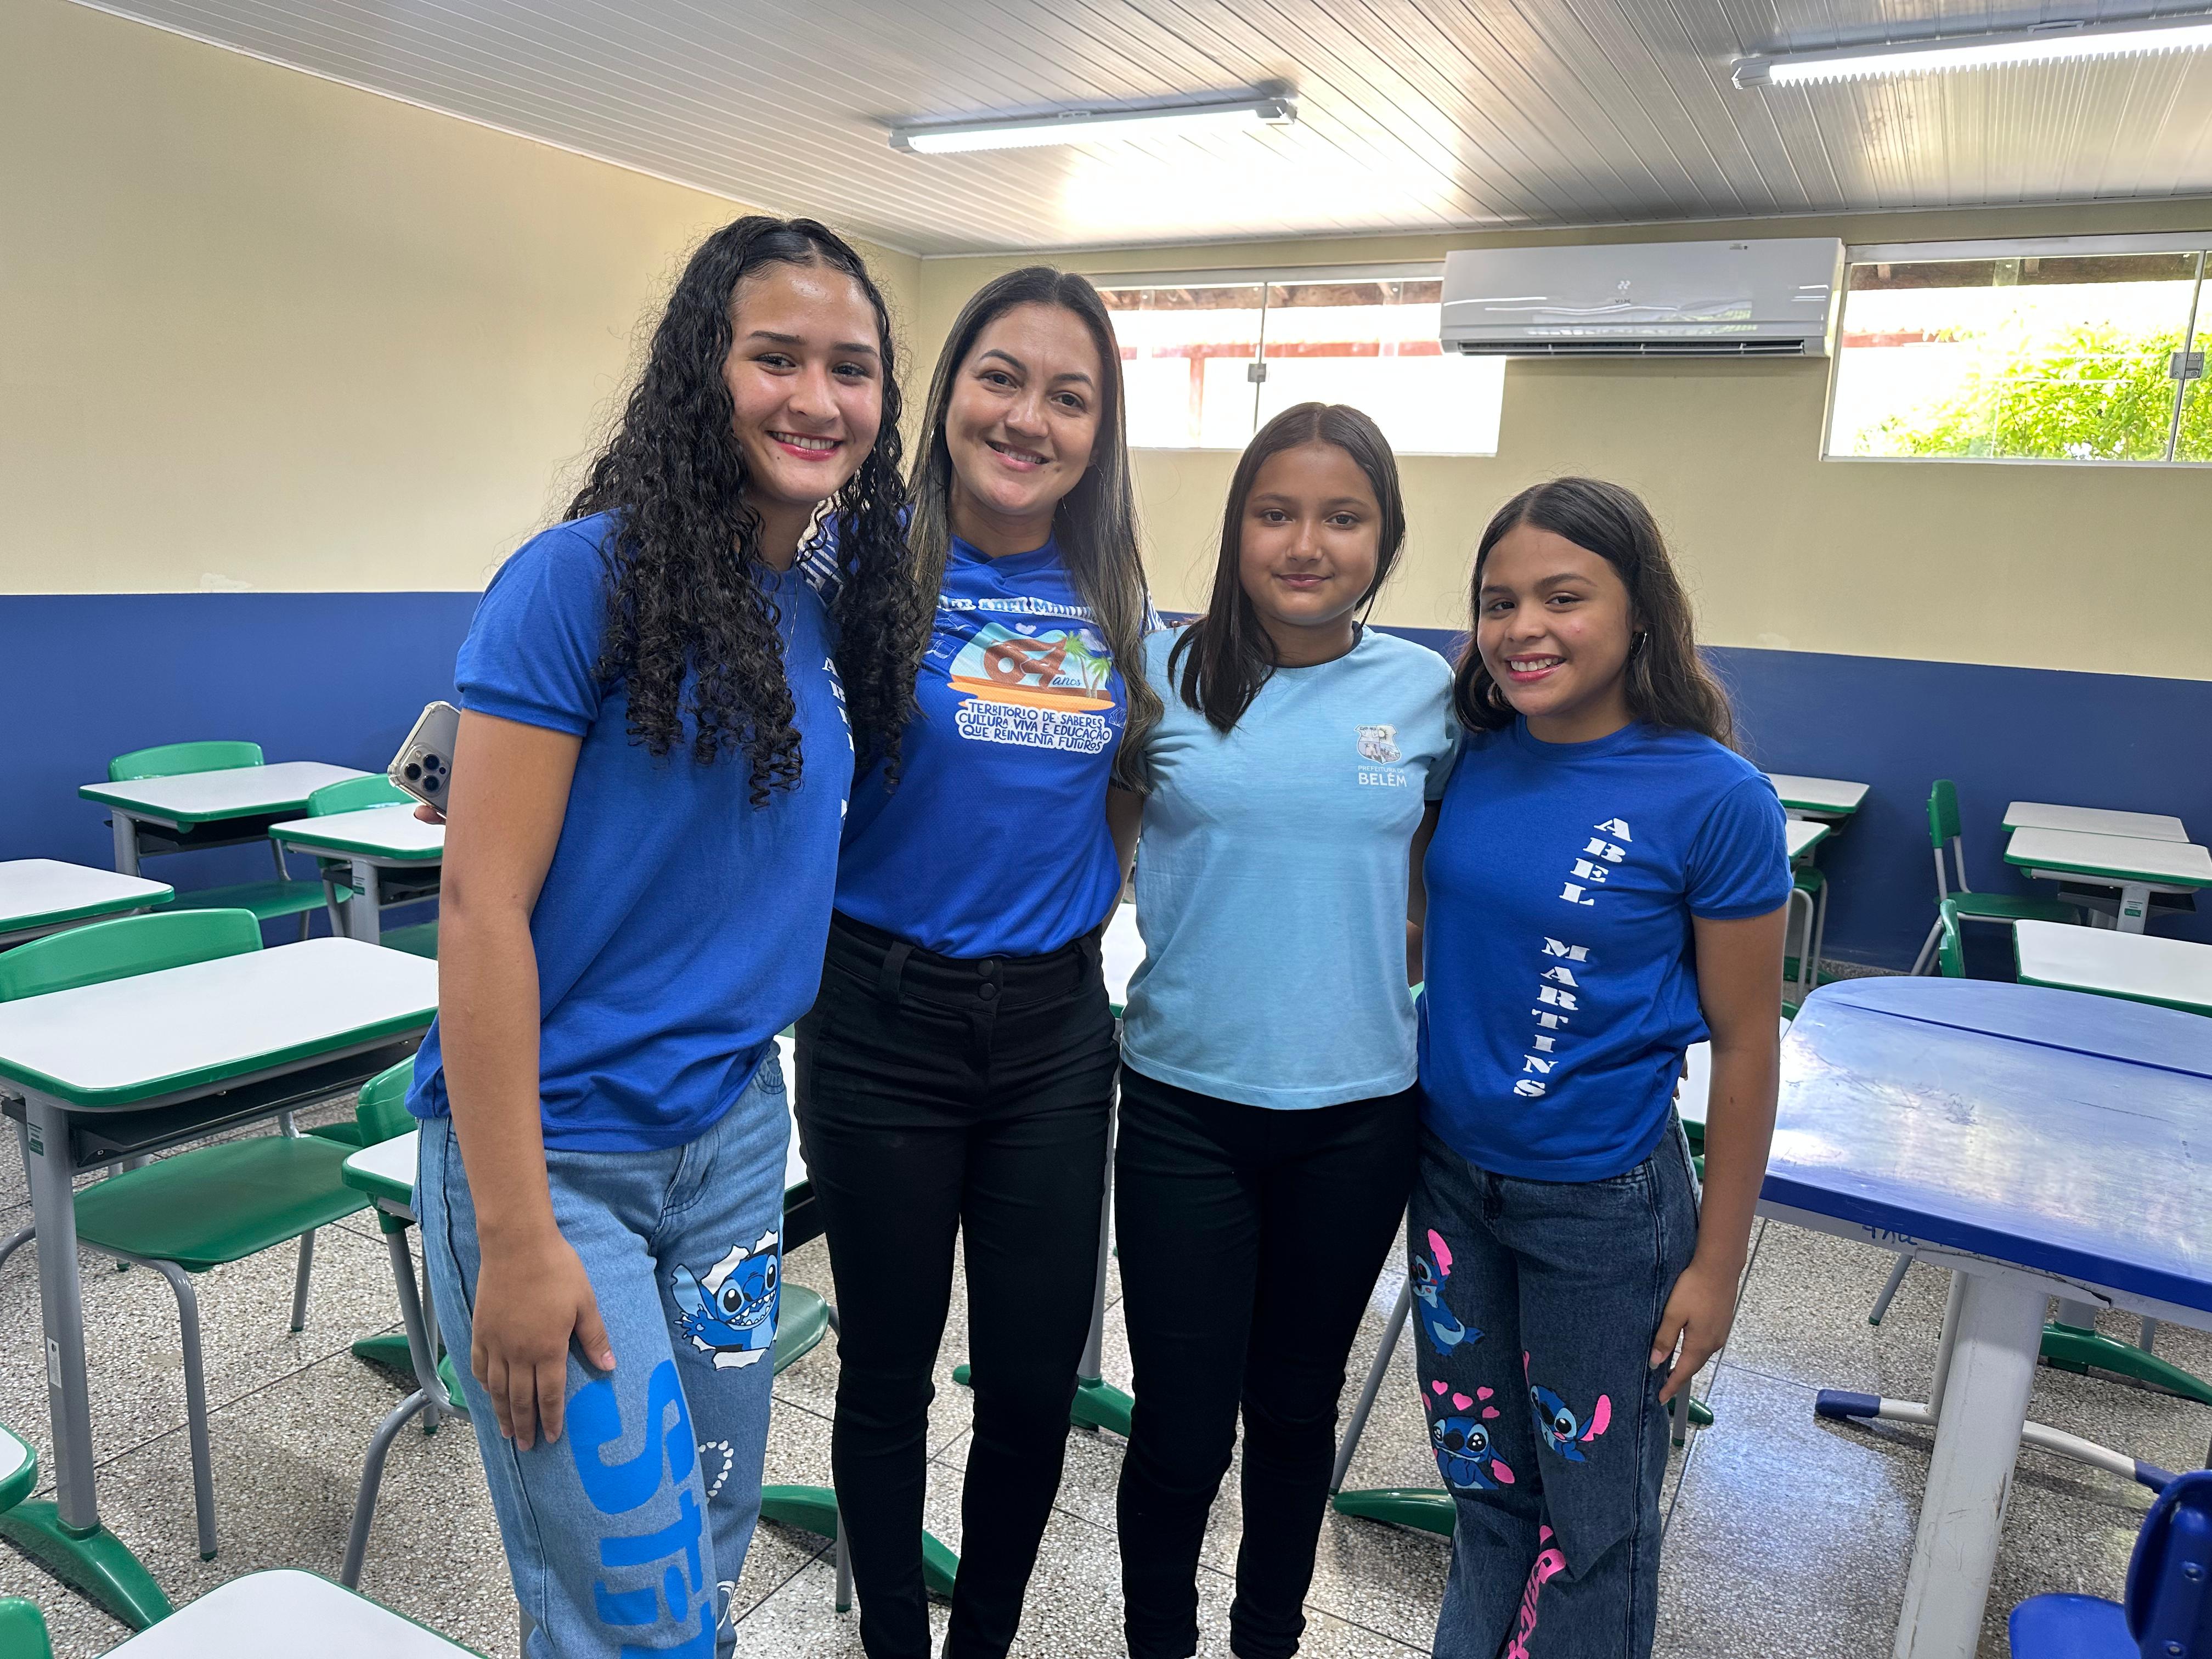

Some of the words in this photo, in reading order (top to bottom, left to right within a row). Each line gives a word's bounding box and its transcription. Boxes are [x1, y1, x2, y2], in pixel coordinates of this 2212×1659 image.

[1052, 676, 1081, 686] anos
[958, 713, 1008, 729] CULTURA
[1013, 719, 1037, 732] VIVA
[1042, 723, 1049, 733] E
[1053, 725, 1110, 742] EDUCAÇÃO
[968, 702, 1038, 720] TERRITÓRIO
[1042, 711, 1056, 723] DE
[1060, 714, 1103, 730] SABERES
[962, 724, 990, 738] QUE
[994, 728, 1054, 746] REINVENTA
[1058, 736, 1102, 751] FUTUROS
[1358, 765, 1397, 774] PREFEITURA
[1358, 772, 1407, 787] BELÉM
[1559, 817, 1633, 906] ABEL
[1513, 936, 1590, 1097] MARTINS
